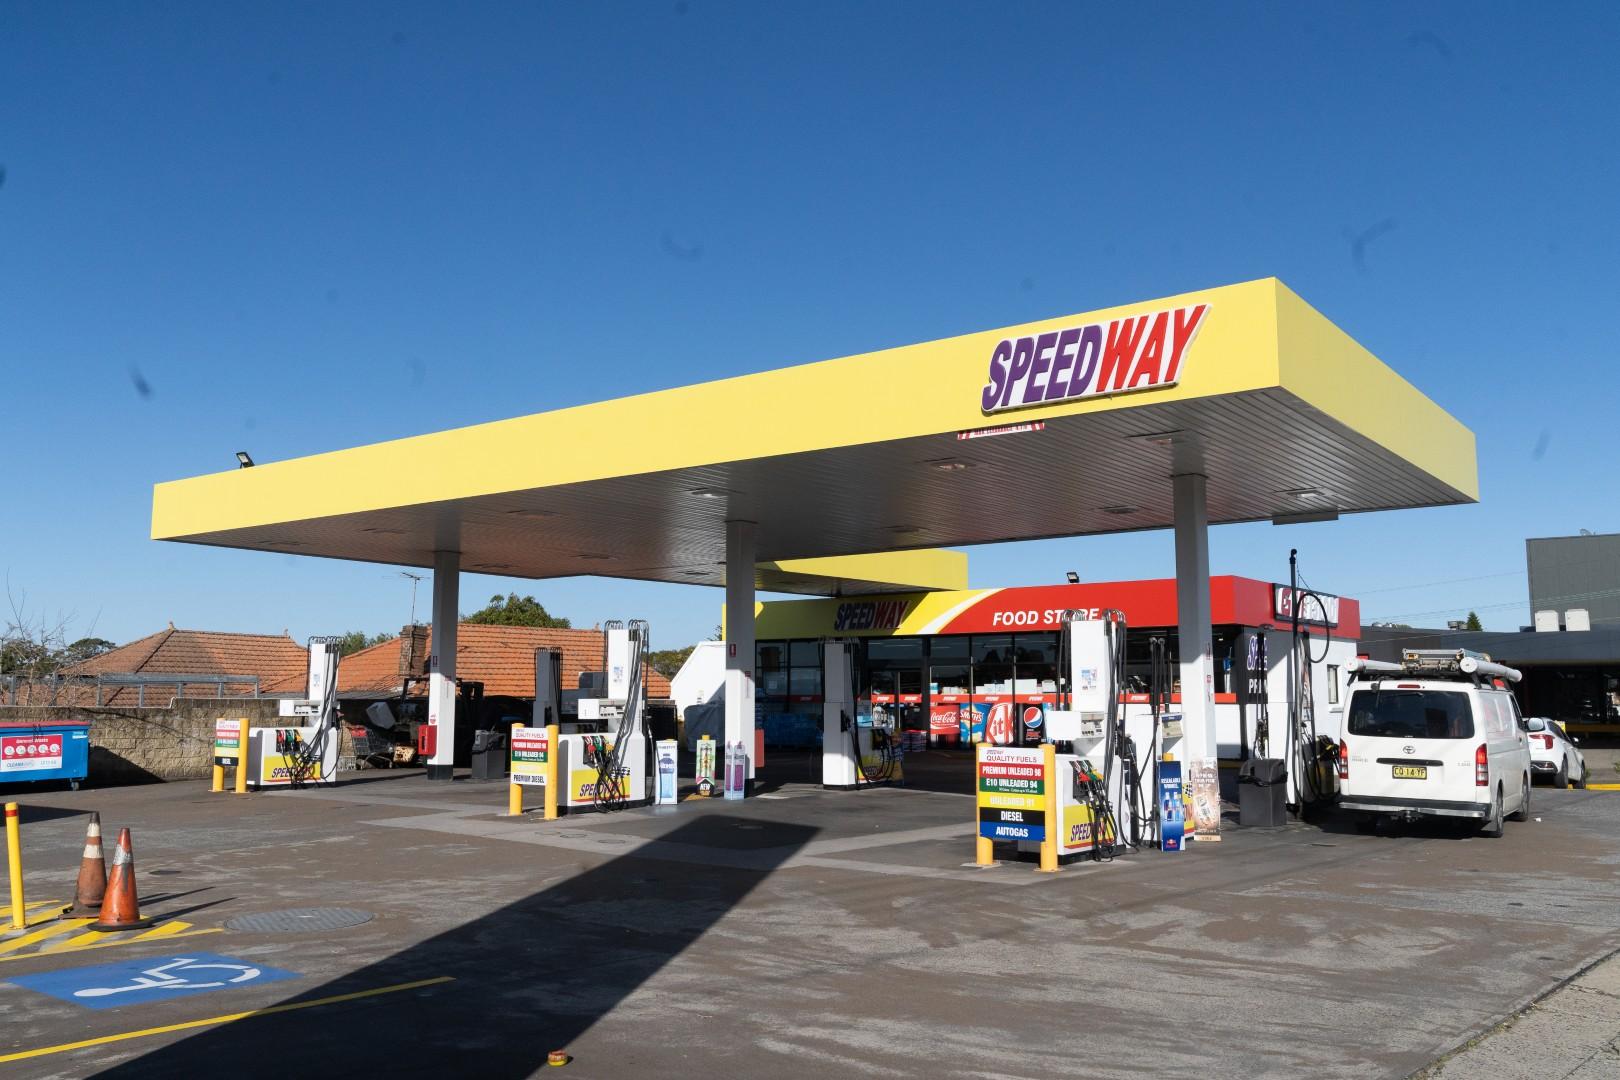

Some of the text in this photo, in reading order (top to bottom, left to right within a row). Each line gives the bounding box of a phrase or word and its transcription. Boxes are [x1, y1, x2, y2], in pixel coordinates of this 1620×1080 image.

[982, 304, 1207, 410] SPEEDWAY
[834, 600, 908, 631] SPEEDWAY
[993, 607, 1099, 626] FOOD STRE
[960, 711, 984, 723] SMTH'S
[982, 766, 1042, 777] PREMIUM UNLEADED 98
[986, 778, 1038, 788] E10 UNLEADED 94
[990, 796, 1024, 806] UNLEADED
[1000, 811, 1024, 822] DIESEL
[996, 826, 1029, 838] AUTOGAS
